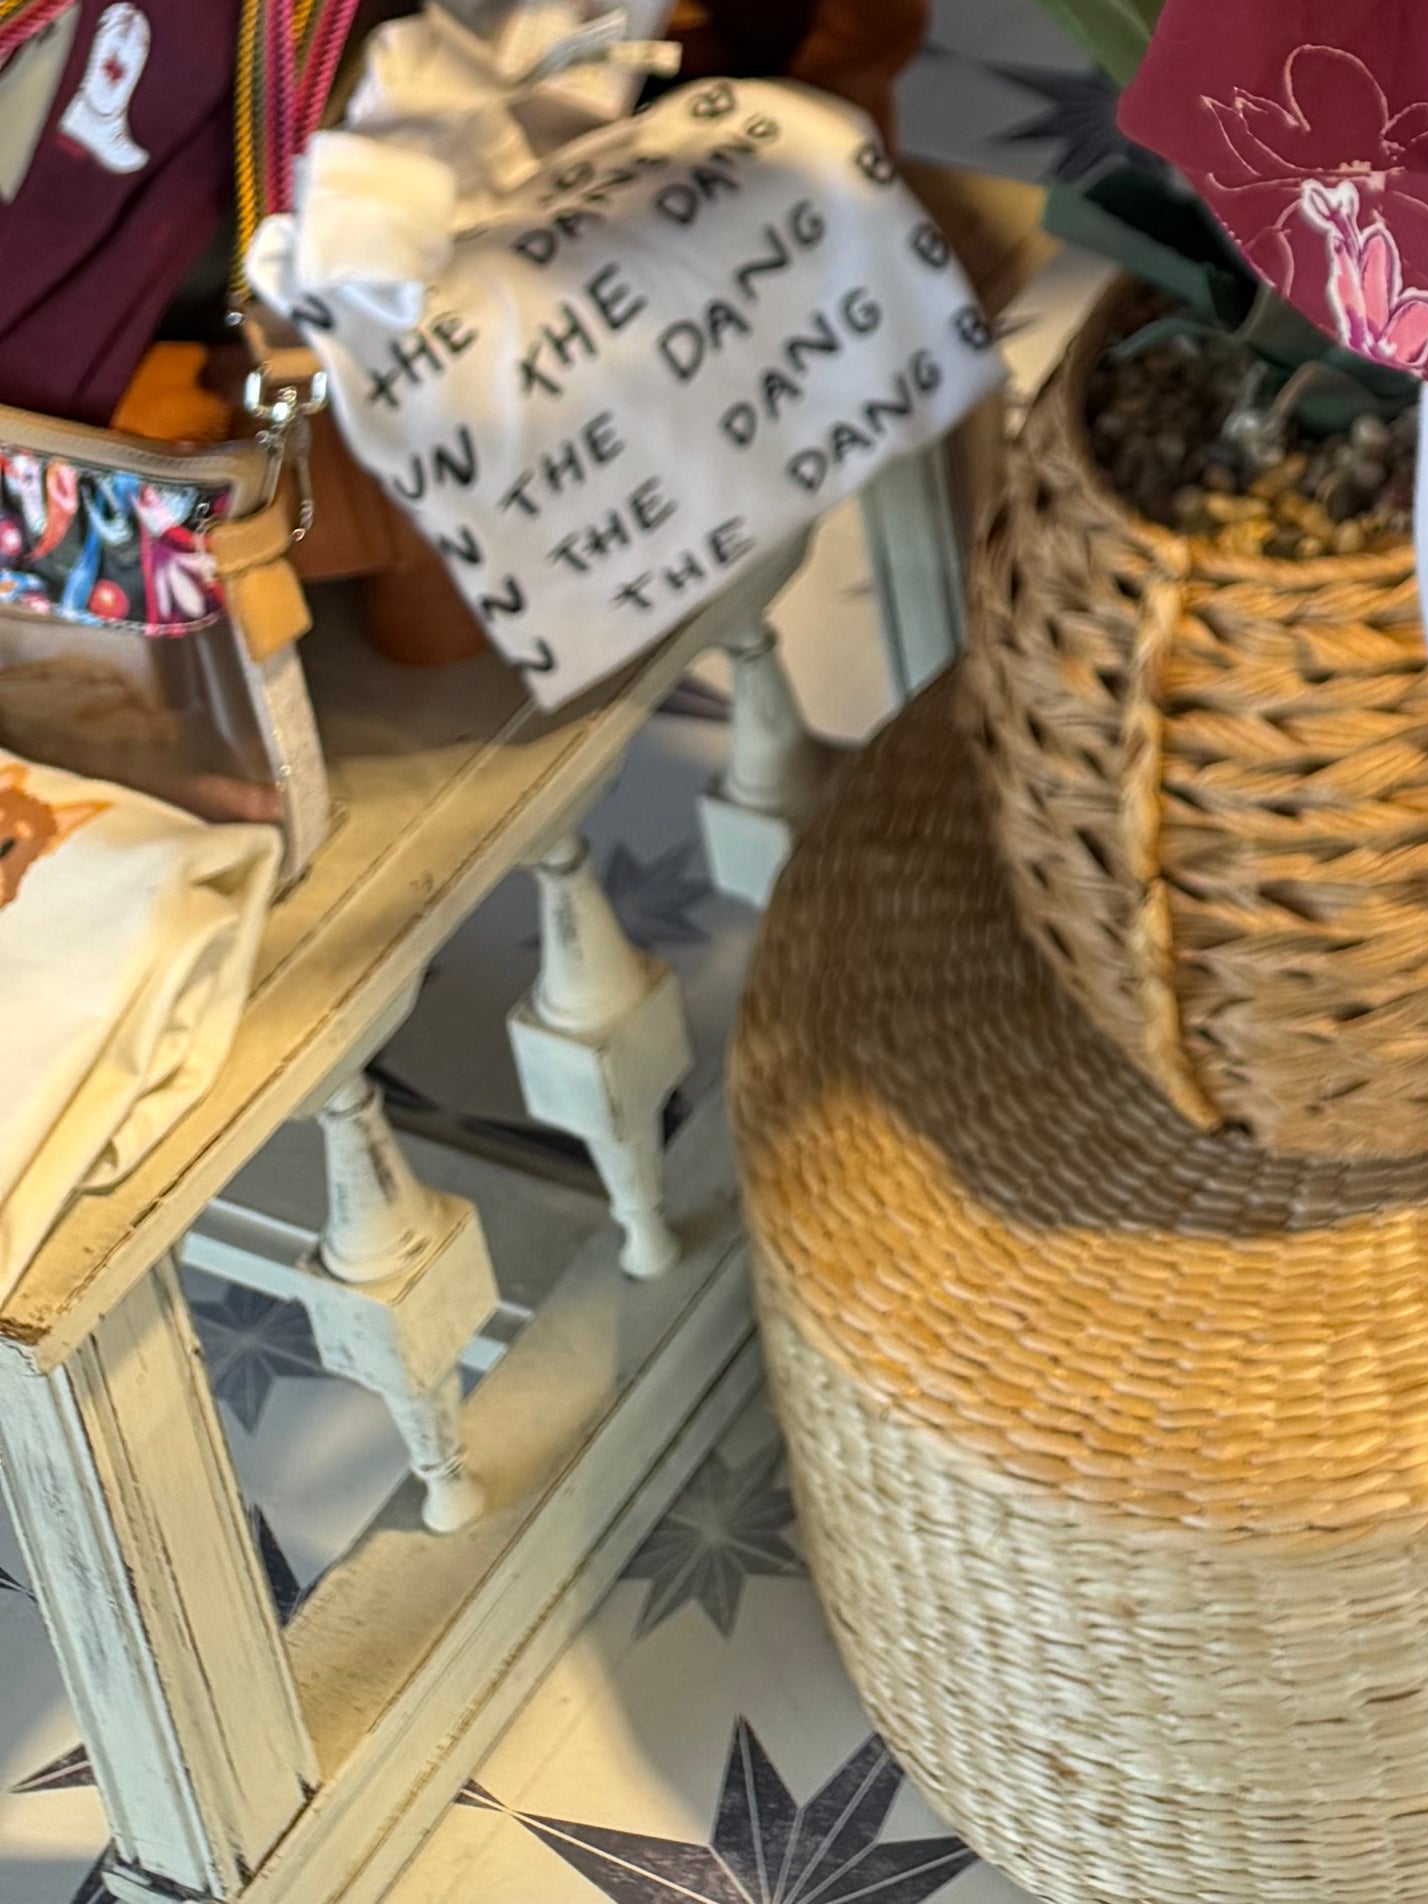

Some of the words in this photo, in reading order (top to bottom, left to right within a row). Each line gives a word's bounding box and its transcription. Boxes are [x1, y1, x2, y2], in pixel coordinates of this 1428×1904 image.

[366, 310, 479, 407] THE
[499, 409, 629, 521] THE
[658, 198, 828, 387] DANG
[518, 261, 647, 401] THE
[654, 112, 781, 228] DANG
[546, 475, 681, 576] THE
[718, 285, 883, 450] DANG
[611, 513, 760, 612] THE
[785, 348, 945, 494] DANG
